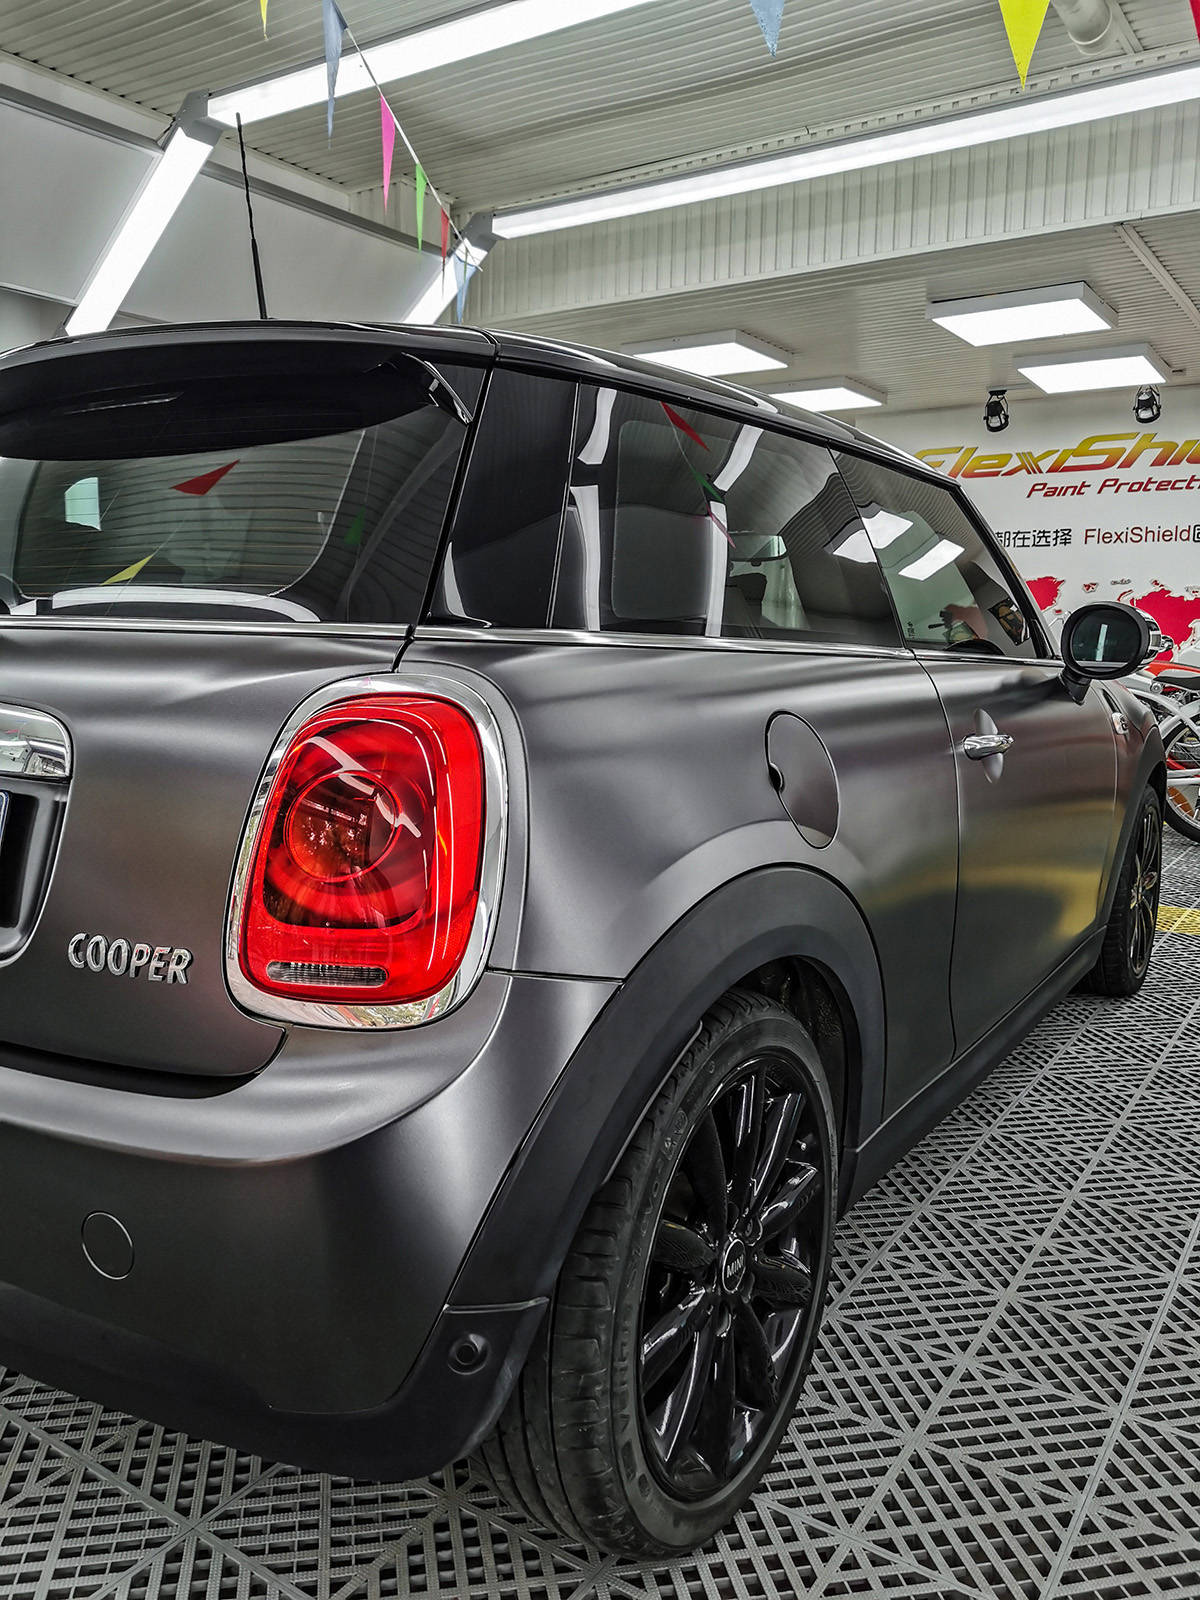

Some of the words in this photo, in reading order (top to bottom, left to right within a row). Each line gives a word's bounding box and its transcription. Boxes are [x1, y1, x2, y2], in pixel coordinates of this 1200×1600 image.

[1026, 481, 1091, 498] Paint
[1097, 475, 1200, 494] Protect
[67, 932, 193, 984] COOPER
[726, 1254, 744, 1278] MINI
